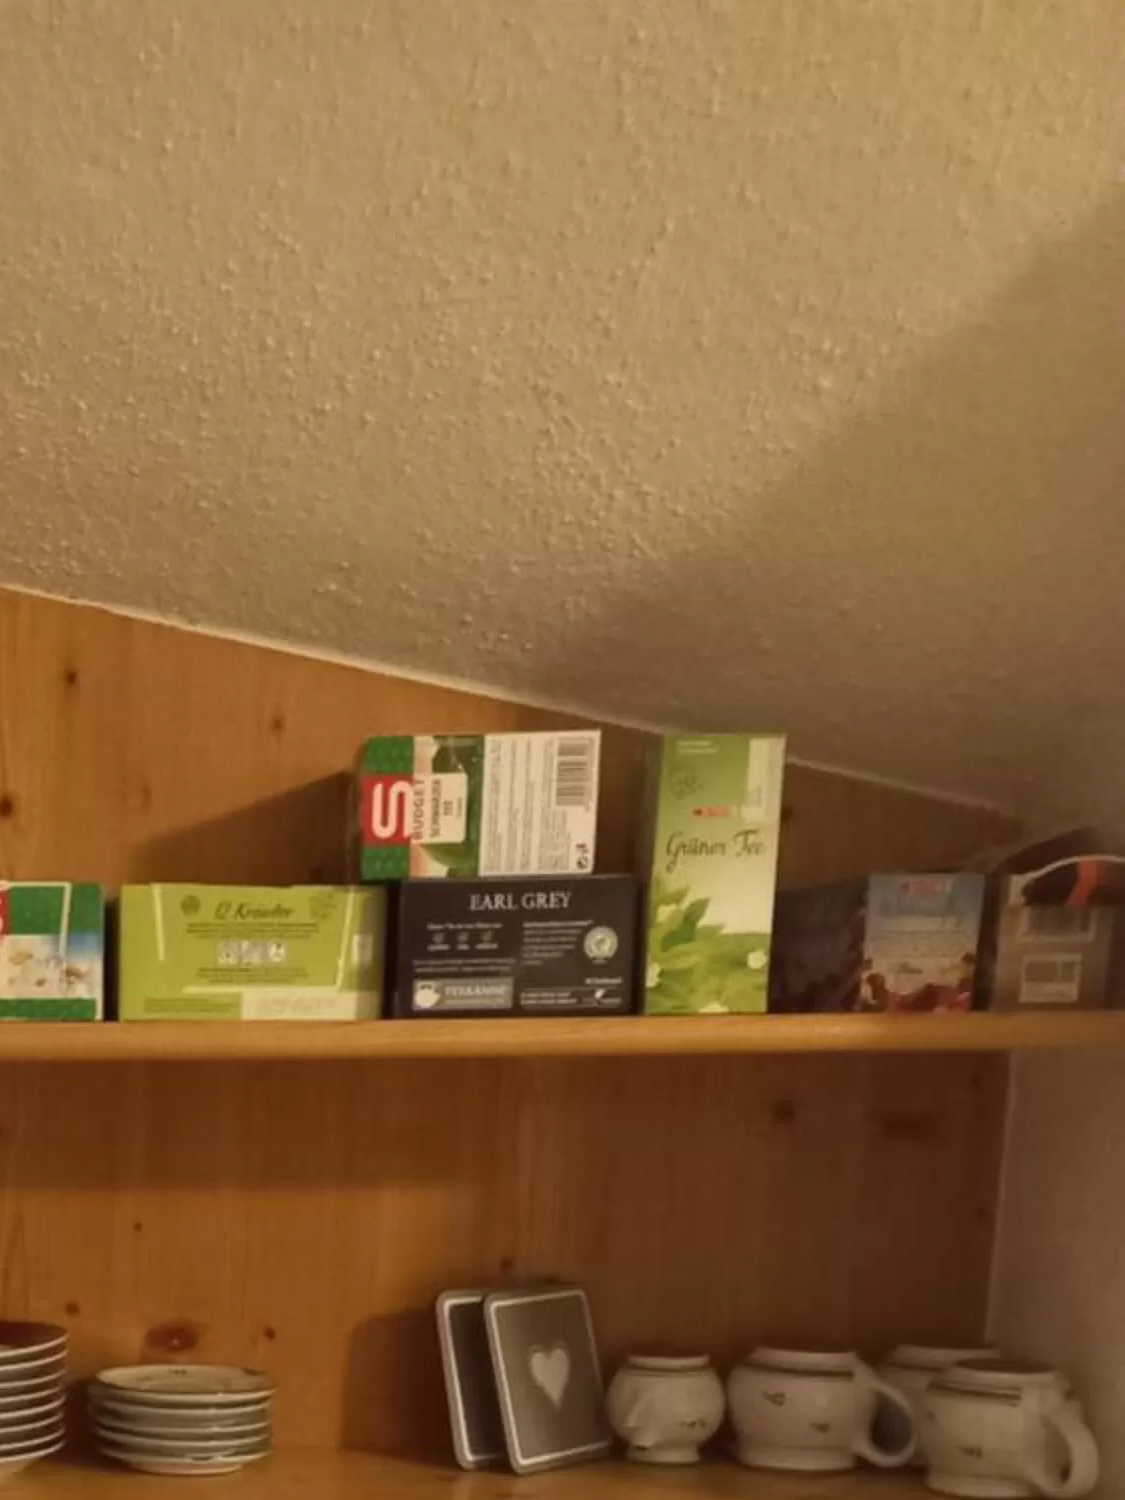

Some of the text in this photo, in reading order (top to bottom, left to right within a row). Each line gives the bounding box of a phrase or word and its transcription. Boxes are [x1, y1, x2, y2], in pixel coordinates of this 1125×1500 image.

[372, 780, 414, 838] S
[412, 779, 425, 840] BUDGET
[733, 828, 764, 858] Tee
[469, 891, 572, 911] EARL GREY
